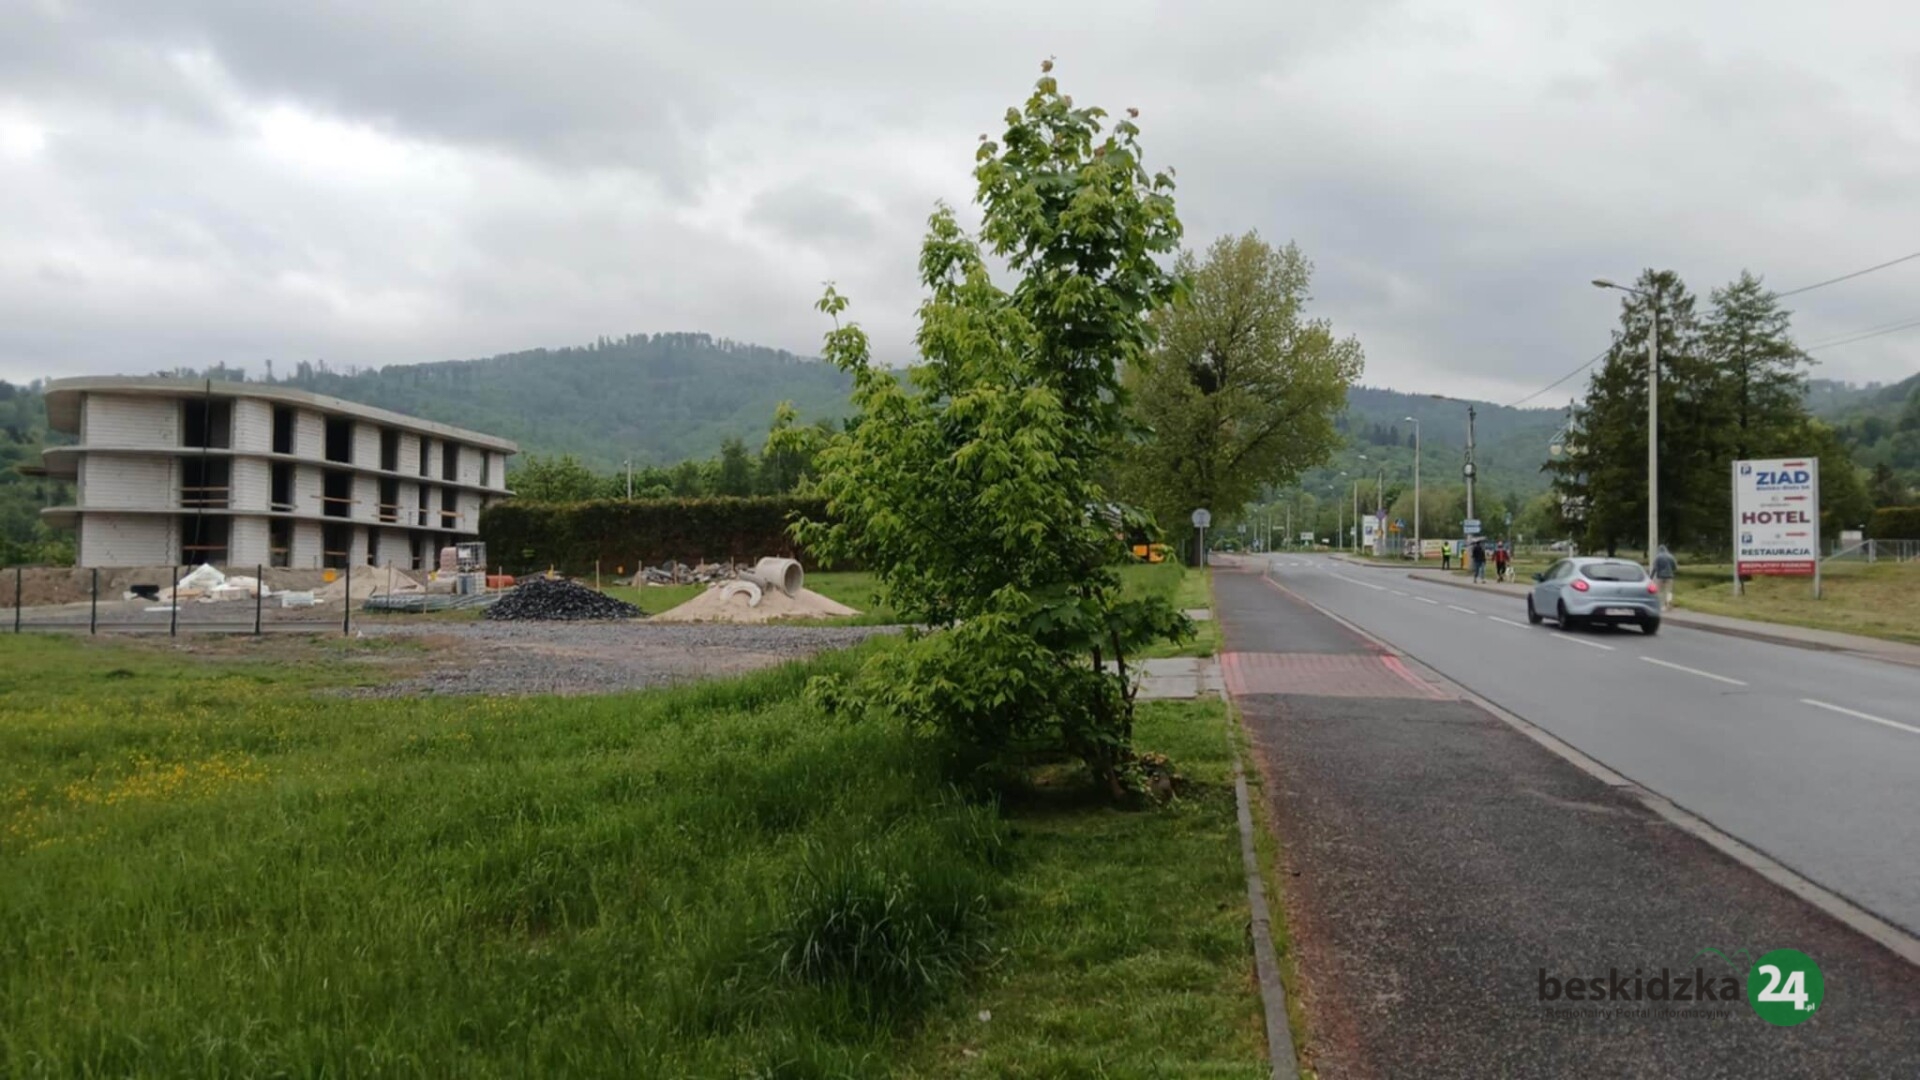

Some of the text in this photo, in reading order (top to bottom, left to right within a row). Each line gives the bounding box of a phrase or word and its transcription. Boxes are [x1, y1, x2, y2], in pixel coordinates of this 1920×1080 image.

[1756, 471, 1810, 485] ZIAD
[1742, 511, 1810, 524] HOTEL
[1741, 548, 1810, 556] RESTAURACJA
